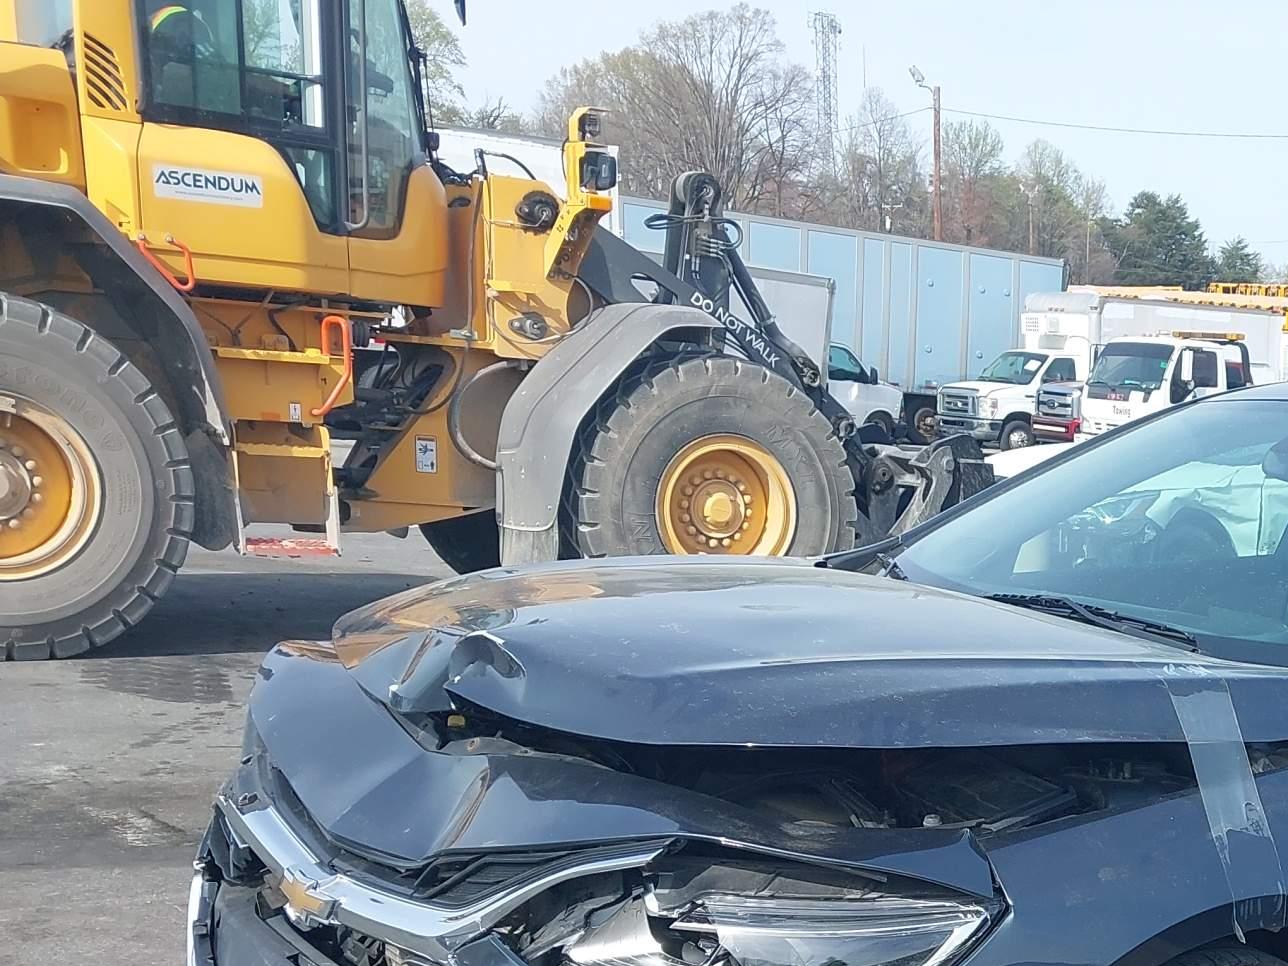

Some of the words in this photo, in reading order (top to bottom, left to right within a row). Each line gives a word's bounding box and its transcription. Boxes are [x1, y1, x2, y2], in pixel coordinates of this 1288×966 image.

[155, 170, 261, 195] ASCENDUM
[690, 291, 714, 313] DO
[714, 307, 746, 334] NOT
[745, 328, 780, 368] WALK
